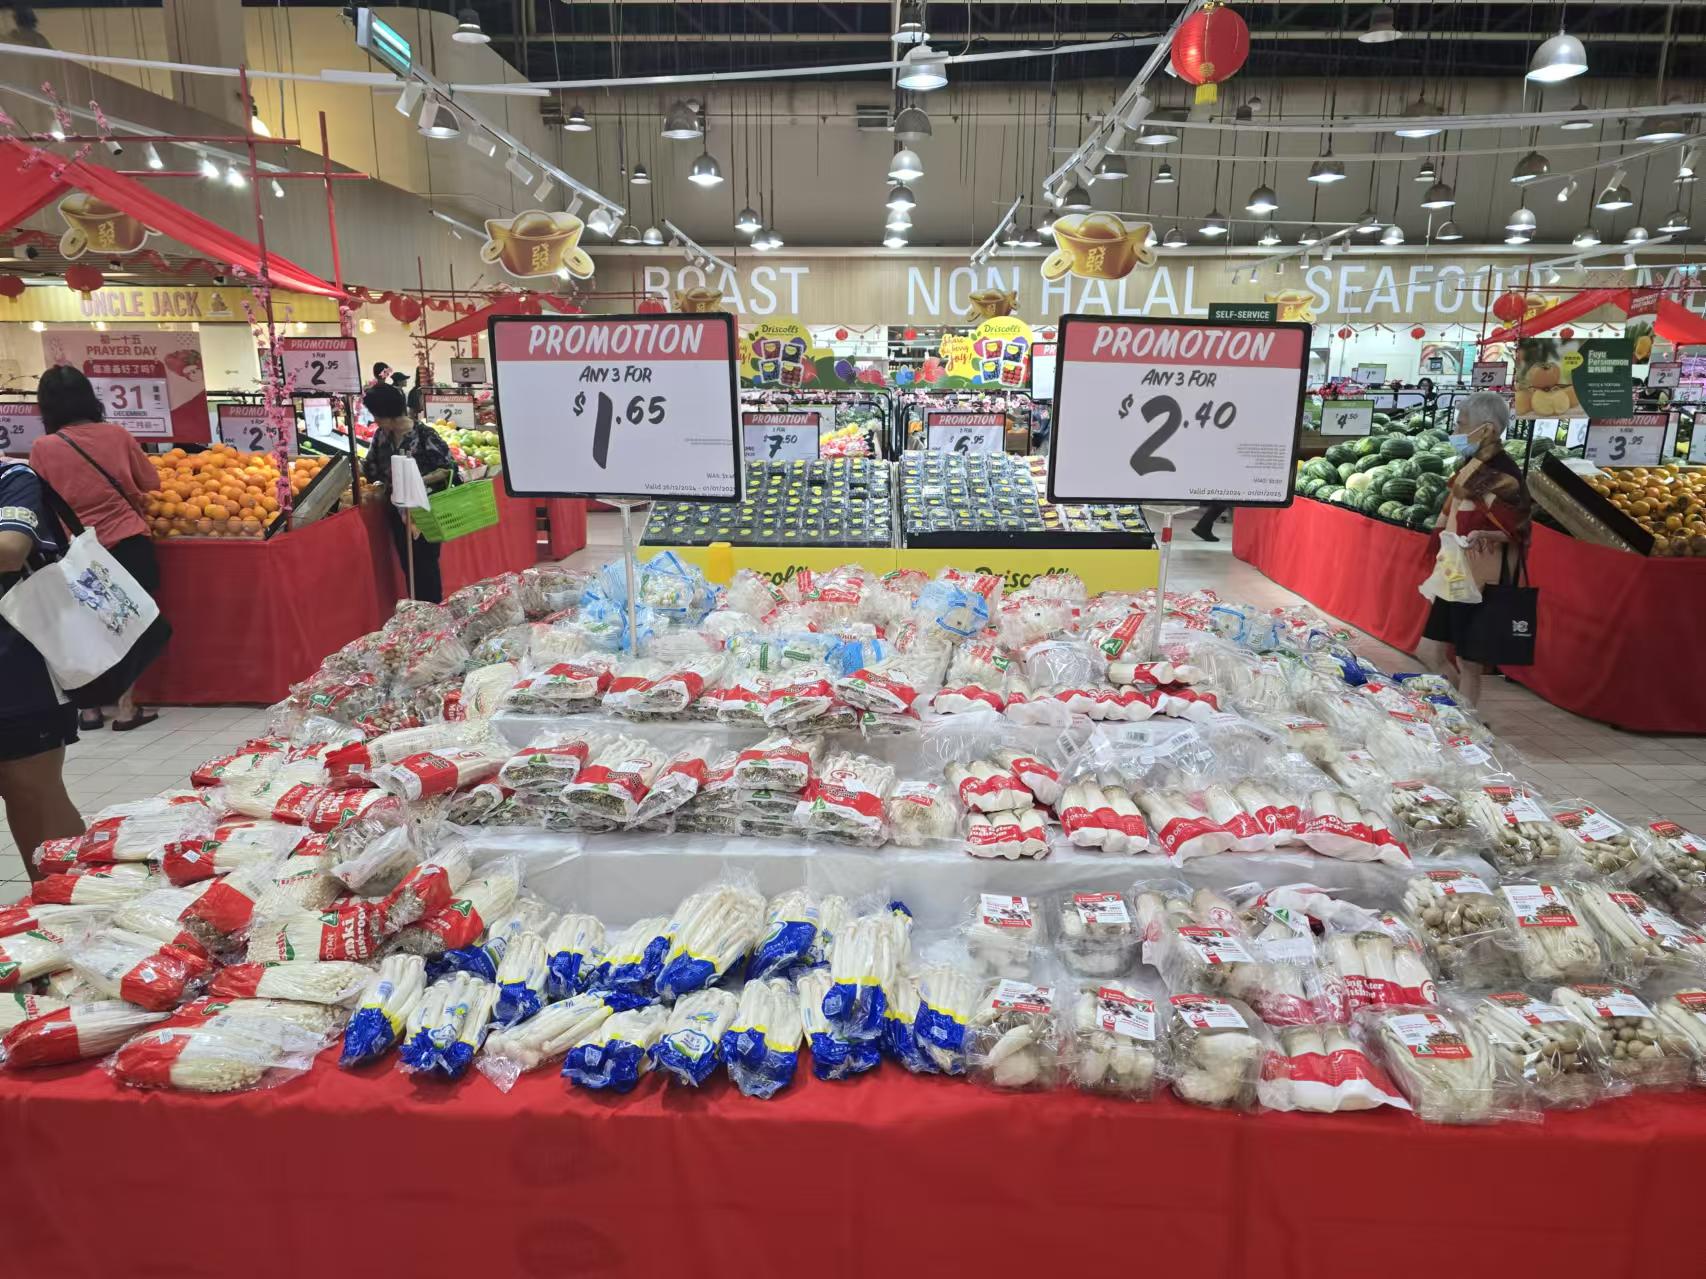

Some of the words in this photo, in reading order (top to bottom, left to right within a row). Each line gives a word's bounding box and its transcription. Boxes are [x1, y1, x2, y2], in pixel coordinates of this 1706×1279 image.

[644, 266, 809, 315] ROAST
[907, 266, 1020, 315] NON
[1041, 266, 1208, 315] HALAL
[81, 291, 145, 317] UNCLE
[150, 291, 202, 317] JACK
[1215, 310, 1269, 319] SELF-SERVICE
[761, 324, 799, 334] Driscoll's
[983, 324, 1022, 333] Driscoll's
[291, 339, 348, 350] PROMOTION
[528, 323, 704, 355] PROMOTION
[1092, 325, 1275, 361] PROMOTION
[87, 346, 133, 356] PRAYER
[134, 346, 157, 356] DAY
[1588, 350, 1607, 359] Fuyu
[579, 365, 610, 383] ANY
[612, 367, 620, 382] 3
[624, 365, 652, 383] FOR
[1141, 369, 1173, 386] ANY
[1175, 372, 1185, 386] 3
[1188, 370, 1217, 388] FOR
[110, 385, 144, 410] 31
[751, 414, 809, 425] PROMOTION
[939, 414, 997, 425] PROMOTION
[573, 391, 667, 469] $1.65
[1118, 394, 1237, 476] $2.40
[763, 433, 798, 459] $7.50
[1608, 435, 1645, 460] $3.95
[644, 483, 661, 491] Valid
